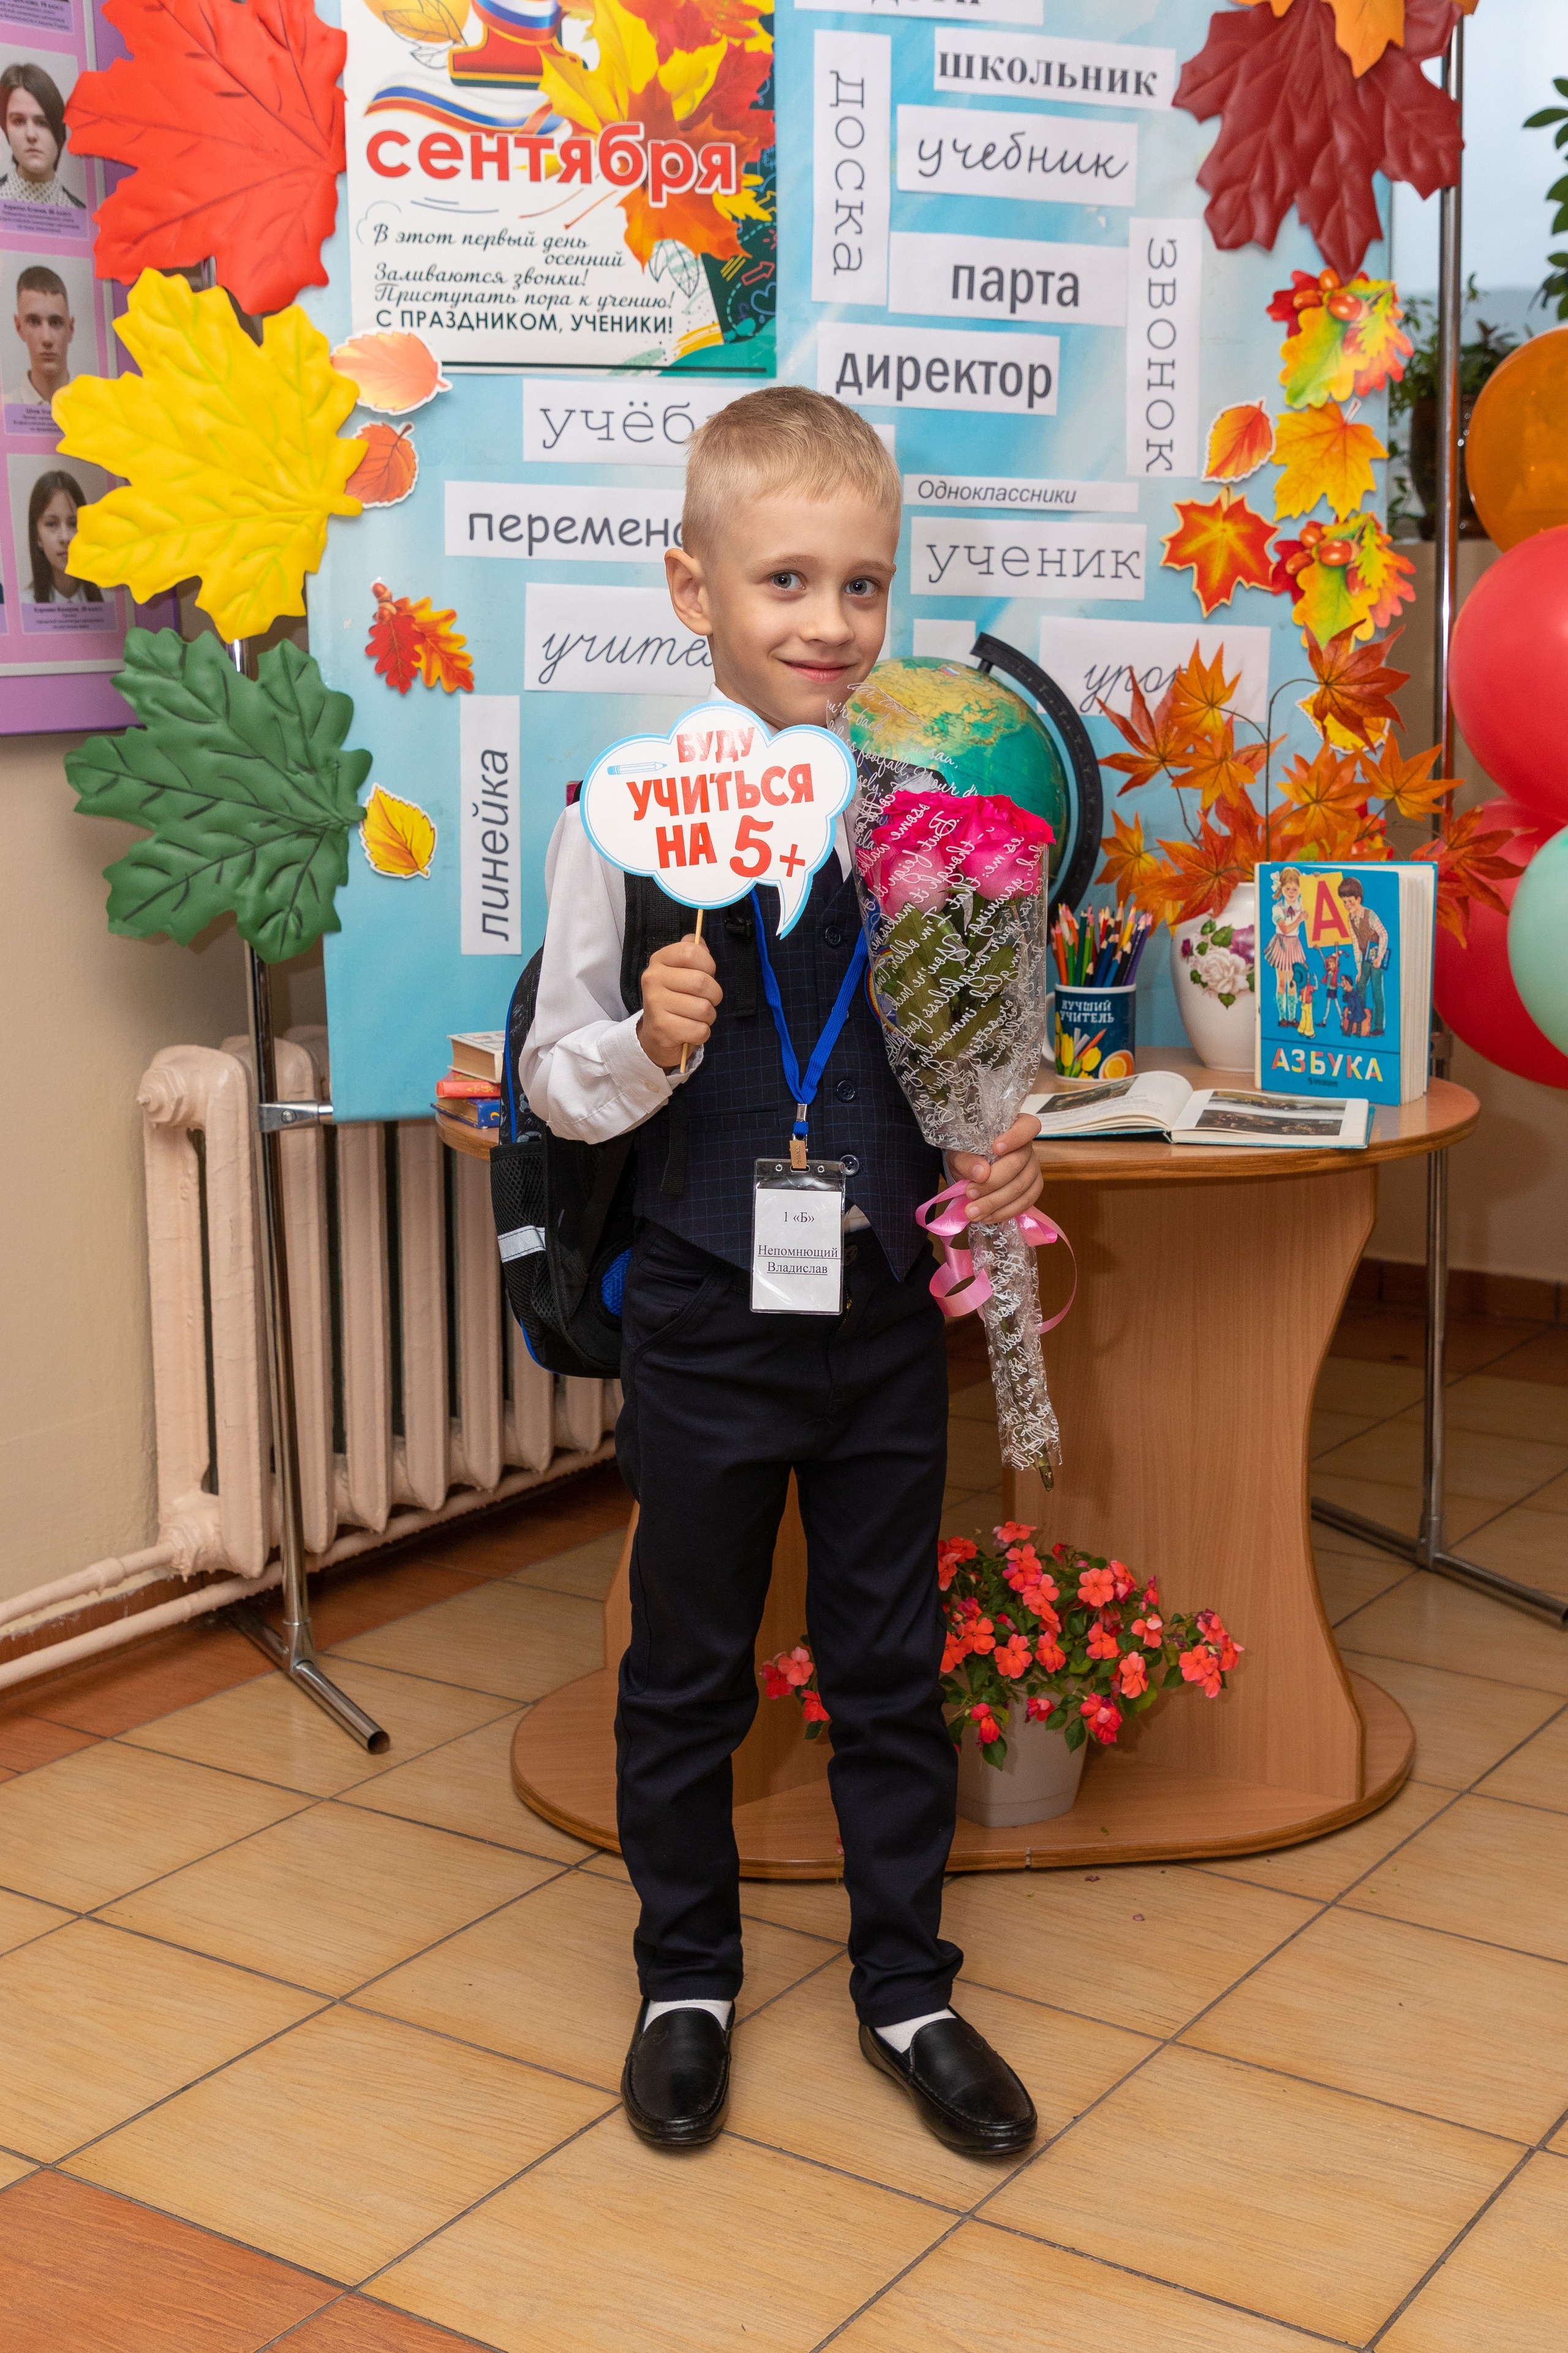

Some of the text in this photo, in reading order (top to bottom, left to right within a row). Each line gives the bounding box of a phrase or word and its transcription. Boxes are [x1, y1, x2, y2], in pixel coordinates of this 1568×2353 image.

[939, 51, 1158, 97] школьник
[366, 121, 738, 206] сентября
[829, 70, 865, 276] доска
[918, 130, 1129, 179] учебник
[374, 223, 589, 254] В этот первый день
[374, 263, 589, 290] Заливаются звонки!
[544, 251, 625, 268] осенний
[374, 282, 675, 313] Приступать пора к учению!
[951, 263, 1080, 315] парта
[376, 309, 673, 334] С ПРАЗДНИКОМ, УЧЕНИКИ!
[1145, 237, 1177, 472] звонок
[835, 352, 1052, 410] директор
[539, 400, 698, 449] учёб
[917, 479, 1077, 505] Одноклассники
[925, 543, 1142, 584] ученик
[1079, 663, 1187, 714] уро
[855, 706, 891, 735] back
[676, 727, 756, 764] БУДУ
[625, 763, 815, 821] УЧИТЬСЯ
[471, 749, 510, 942] линейка
[655, 821, 718, 869] НА
[1311, 880, 1351, 942] А
[1060, 1010, 1115, 1023] УЧИТЕЛЬ
[1061, 1000, 1112, 1011] ЛУЧШИЙ
[1272, 1048, 1383, 1082] АЗБУКА
[793, 1211, 815, 1223] «Б»
[758, 1244, 838, 1258] Непомнющий
[767, 1261, 827, 1274] Владислав
